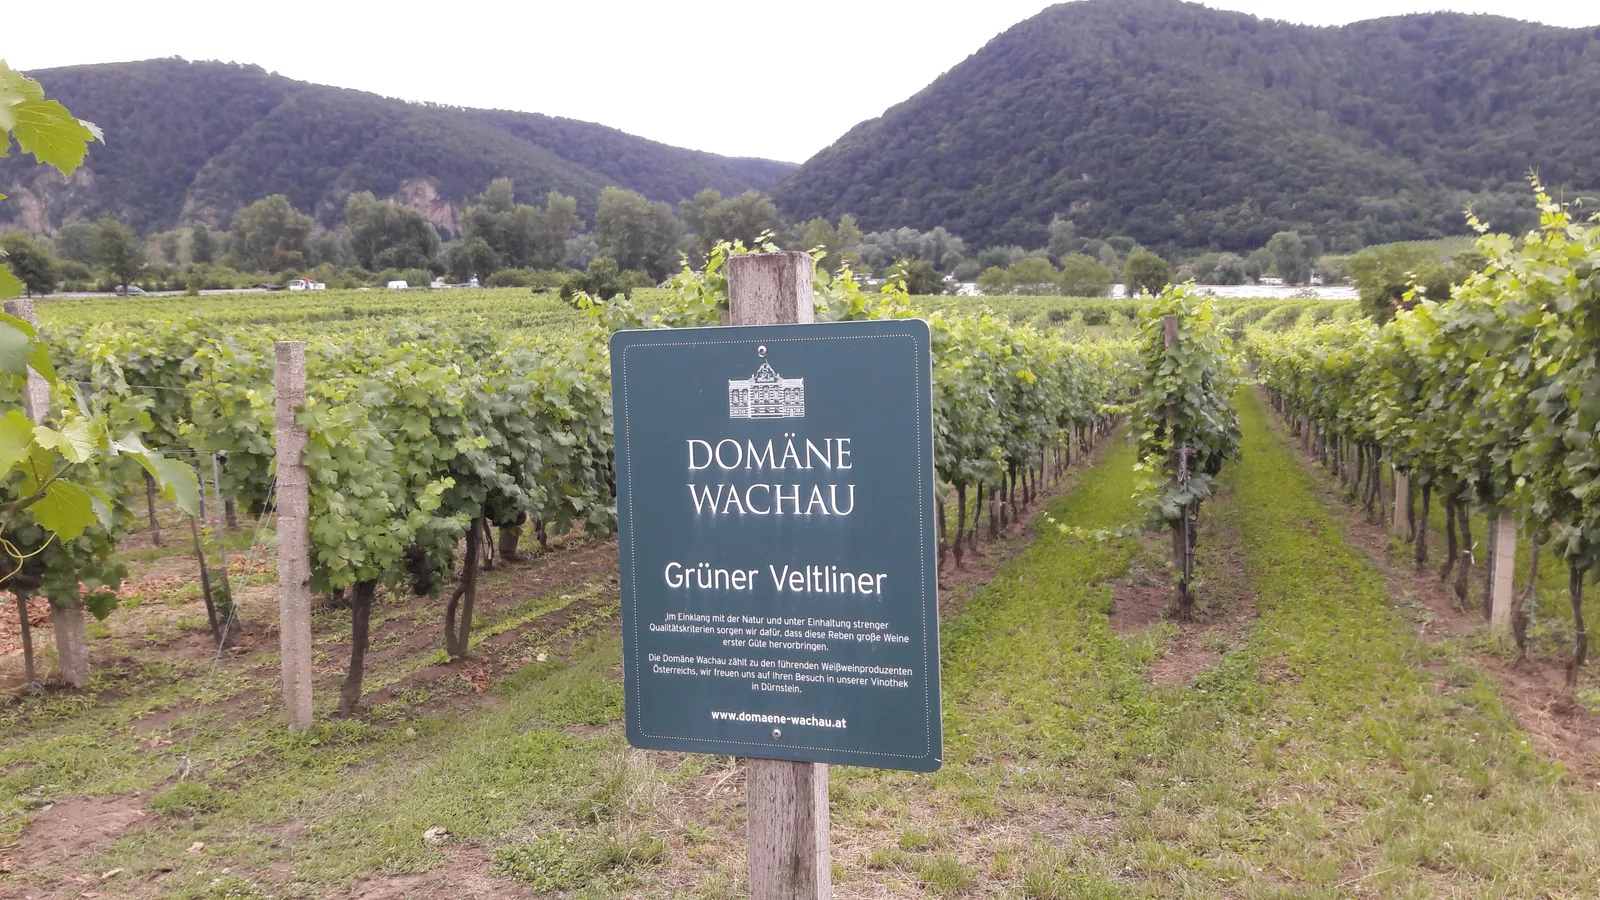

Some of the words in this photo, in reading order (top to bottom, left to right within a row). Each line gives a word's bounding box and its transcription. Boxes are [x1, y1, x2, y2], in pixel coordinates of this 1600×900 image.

[686, 433, 852, 470] DOMÄNE
[687, 484, 856, 516] WACHAU
[664, 562, 759, 591] Grüner
[769, 564, 888, 595] Veltliner
[678, 612, 710, 624] Einklang
[712, 614, 725, 623] mit
[727, 615, 740, 623] der
[742, 615, 764, 624] Natur
[766, 616, 782, 625] und
[784, 617, 805, 626] unter
[807, 617, 851, 630] Einhaltung
[853, 620, 889, 631] strenger
[649, 623, 715, 634] Qualitätskriterien
[716, 627, 743, 636] sorgen
[745, 627, 757, 635] wir
[759, 628, 782, 637] dafür,
[784, 629, 803, 638] dass
[804, 629, 826, 639] diese
[828, 630, 854, 640] Reben
[856, 632, 881, 643] große
[883, 633, 909, 643] Weine
[723, 638, 746, 647] erster
[748, 639, 767, 648] Güte
[769, 640, 829, 652] hervorbringen.
[648, 653, 661, 662] Die
[663, 654, 694, 663] Domäne
[696, 656, 726, 665] Wachau
[728, 657, 747, 666] zählt
[760, 659, 776, 668] den
[777, 659, 819, 670] führenden
[821, 662, 913, 676] Weißweinproduzenten
[653, 664, 698, 676] Österreichs,
[700, 667, 712, 676] wir
[713, 668, 739, 677] freuen
[757, 671, 770, 679] auf
[772, 671, 793, 680] Ihren
[795, 672, 825, 683] Besuch
[826, 674, 834, 683] in
[836, 677, 868, 685] unserer
[870, 677, 909, 688] Vinothek
[752, 682, 759, 690] in
[761, 682, 802, 693] Dürnstein.
[711, 711, 847, 729] www.domaene-wachau.at
